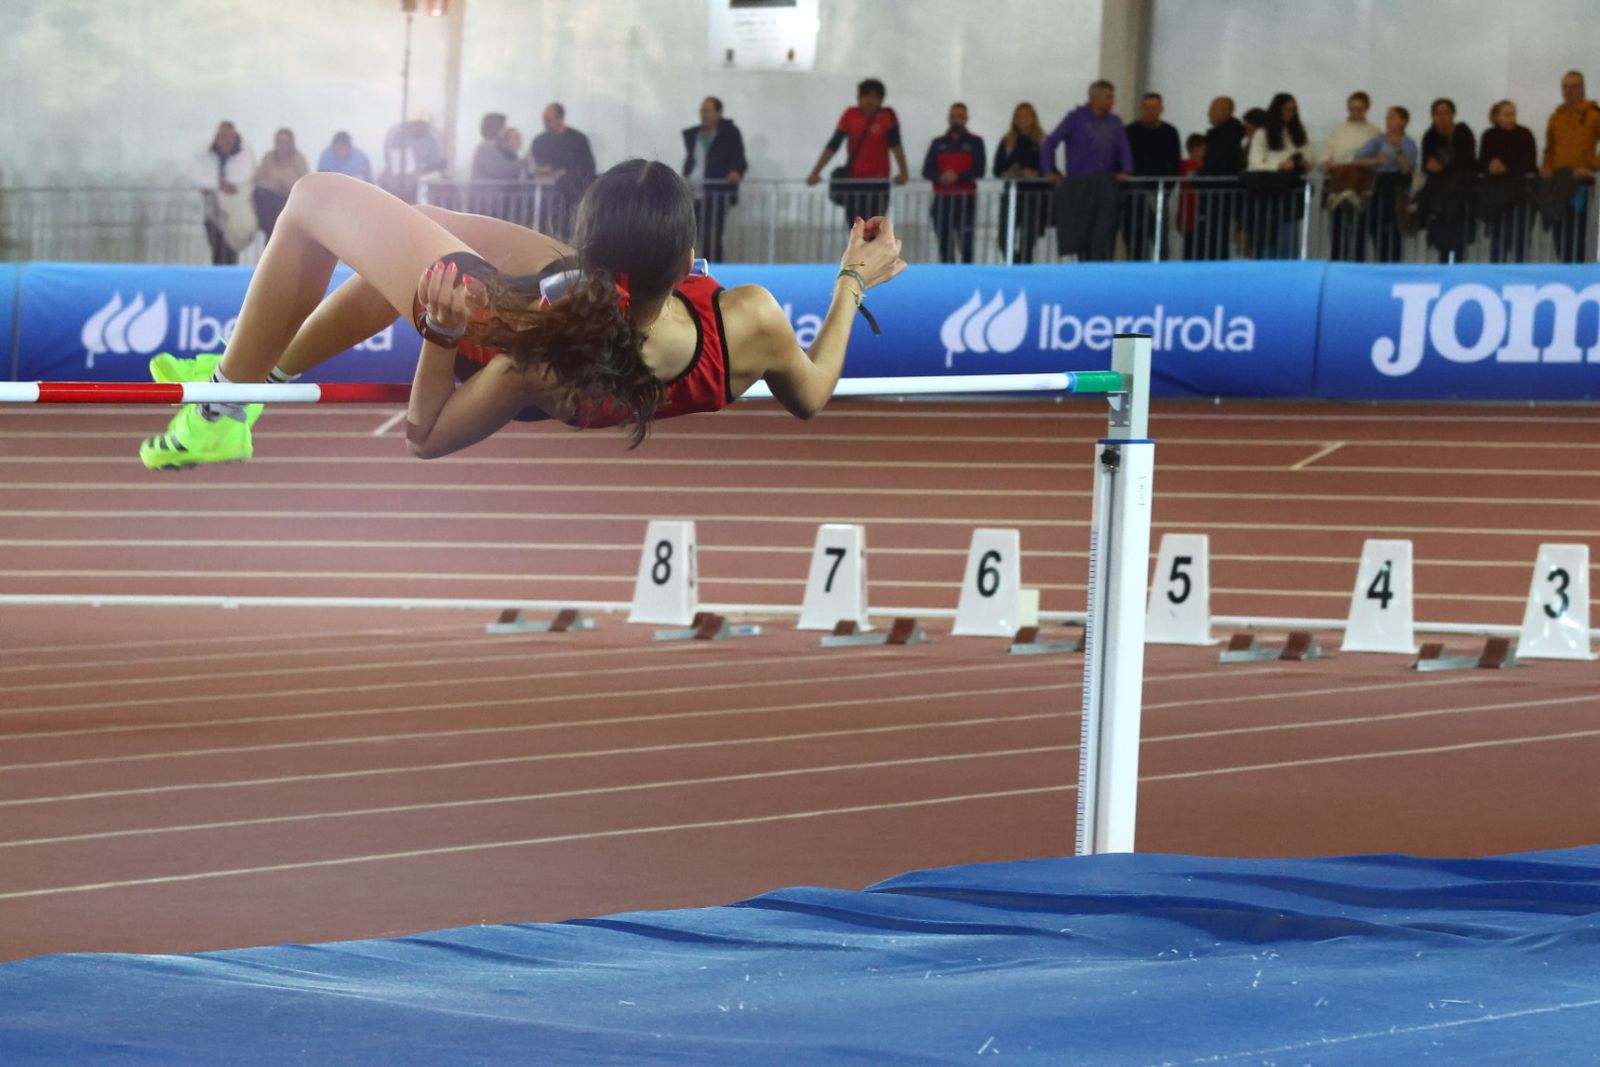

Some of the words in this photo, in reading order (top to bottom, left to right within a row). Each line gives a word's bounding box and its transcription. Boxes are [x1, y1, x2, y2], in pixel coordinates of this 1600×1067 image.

[1039, 304, 1255, 351] Iberdrola
[651, 540, 673, 586] 8
[825, 547, 846, 593] 7
[977, 549, 1002, 598] 6
[1167, 556, 1193, 605] 5
[1367, 560, 1393, 610] 4
[1543, 567, 1570, 619] 3
